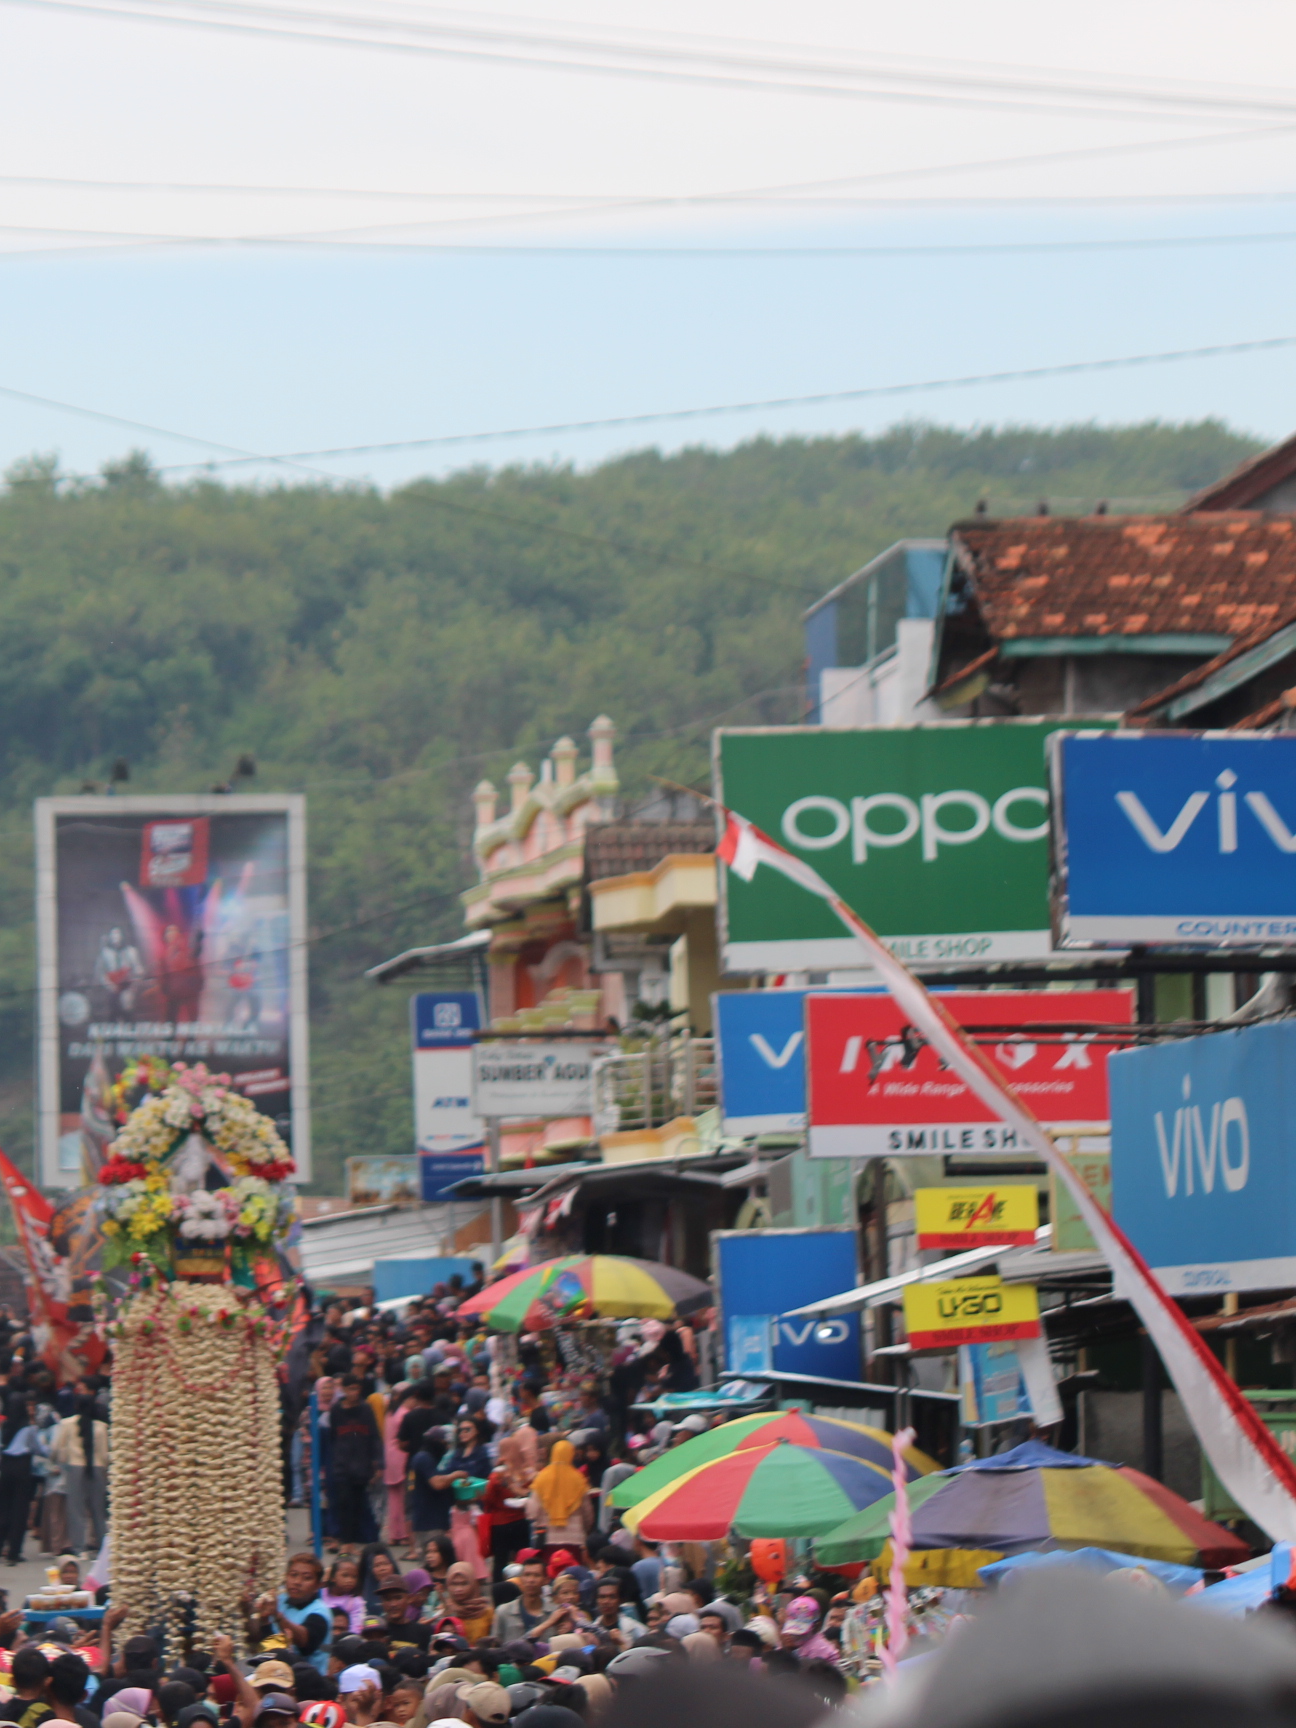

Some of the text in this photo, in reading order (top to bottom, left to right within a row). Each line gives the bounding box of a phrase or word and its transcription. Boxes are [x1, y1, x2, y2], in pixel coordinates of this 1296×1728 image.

[933, 936, 993, 959] SHOP
[888, 1128, 1035, 1151] SMILE SH
[1155, 1073, 1250, 1200] vivo
